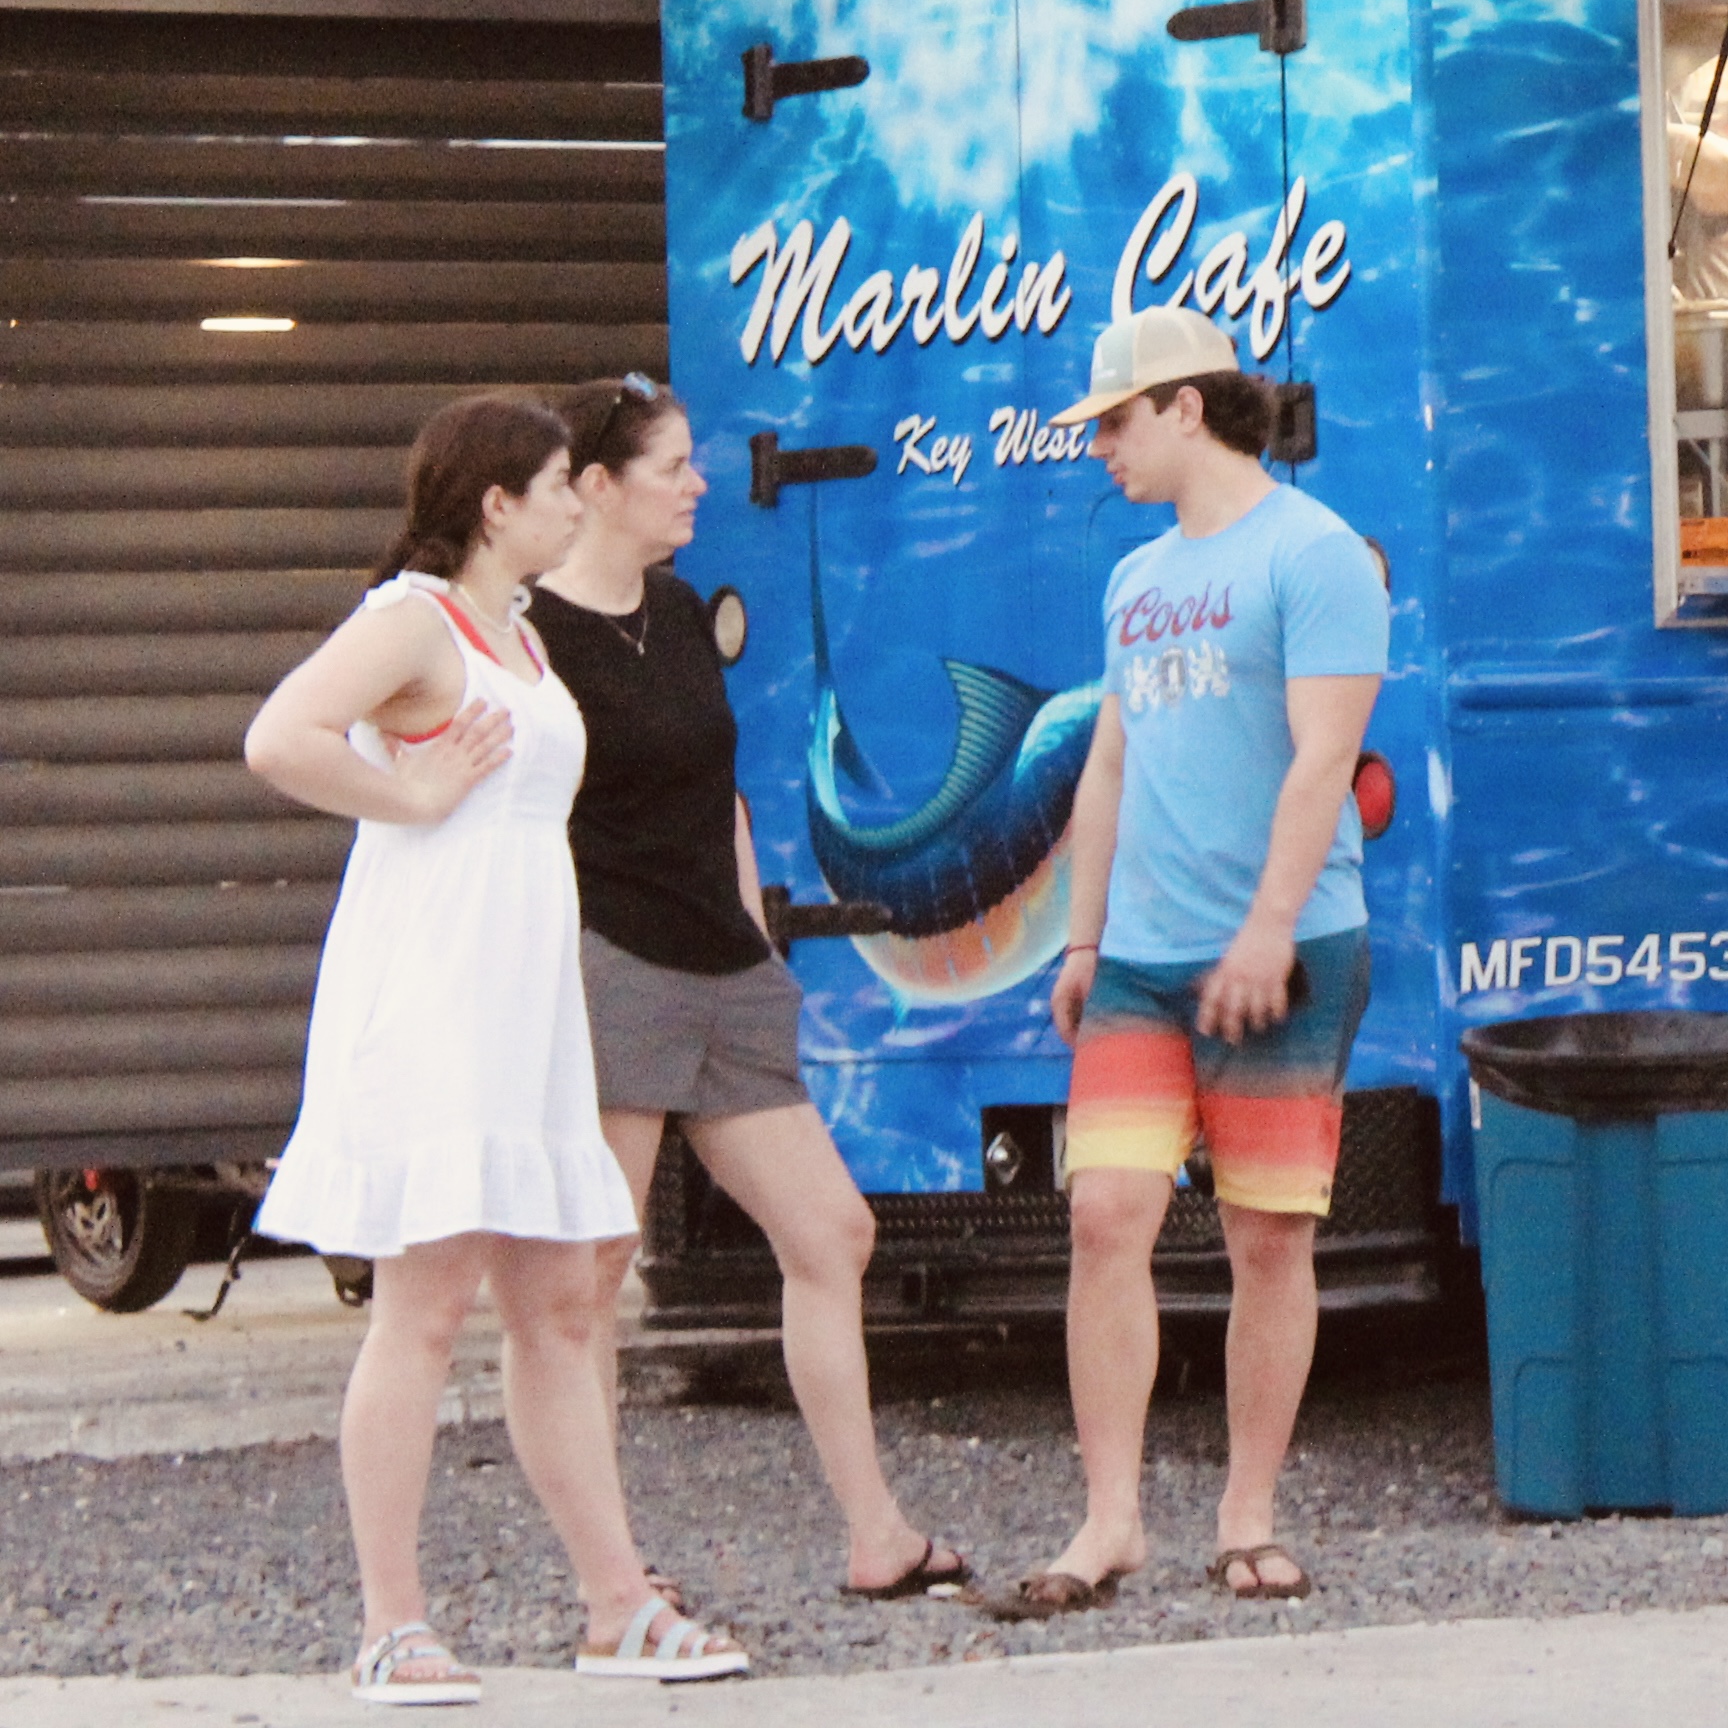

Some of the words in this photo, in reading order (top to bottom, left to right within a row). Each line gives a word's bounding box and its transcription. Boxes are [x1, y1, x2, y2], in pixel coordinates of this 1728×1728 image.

[730, 211, 1070, 364] Marlin
[1112, 172, 1351, 360] Cafe
[894, 413, 973, 486] Key
